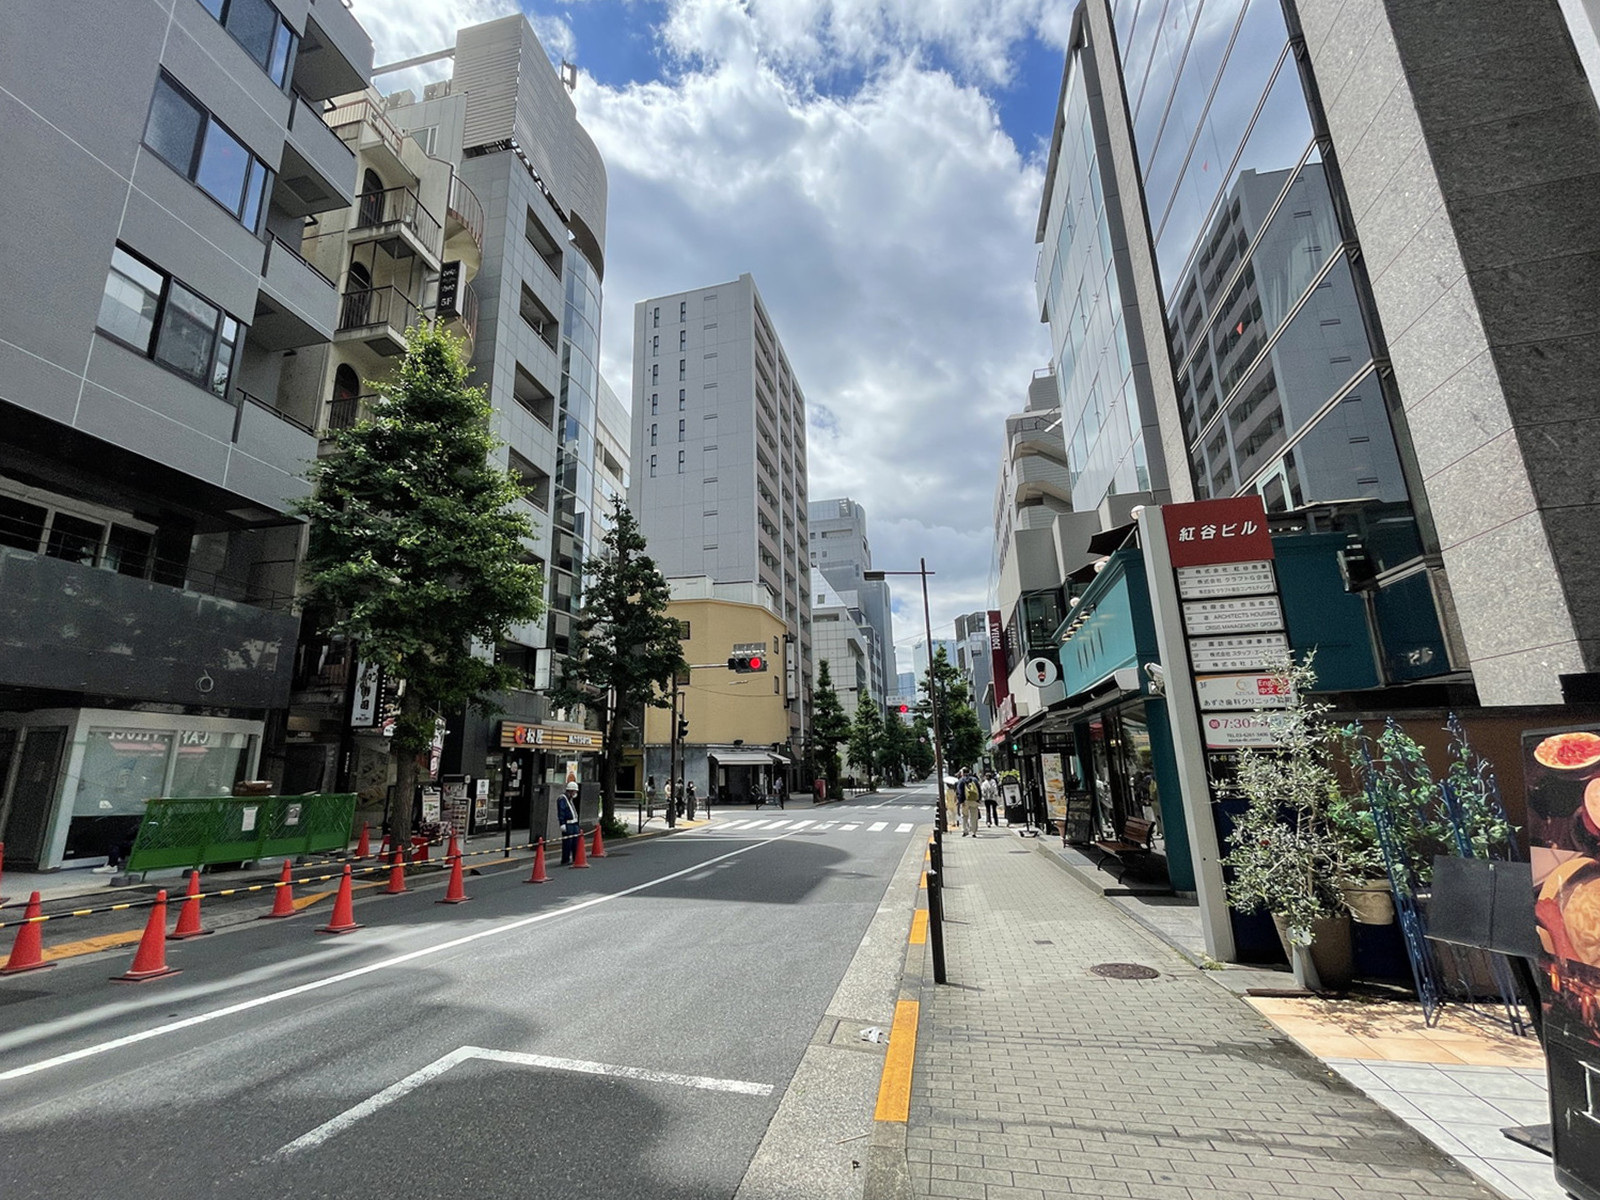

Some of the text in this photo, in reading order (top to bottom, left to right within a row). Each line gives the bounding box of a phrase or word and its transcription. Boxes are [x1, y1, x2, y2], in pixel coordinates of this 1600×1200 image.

[1179, 521, 1258, 541] 紅谷ビル
[1213, 612, 1250, 620] ARCHITECTS
[1250, 610, 1278, 618] HOUSING
[526, 728, 544, 744] 松屋
